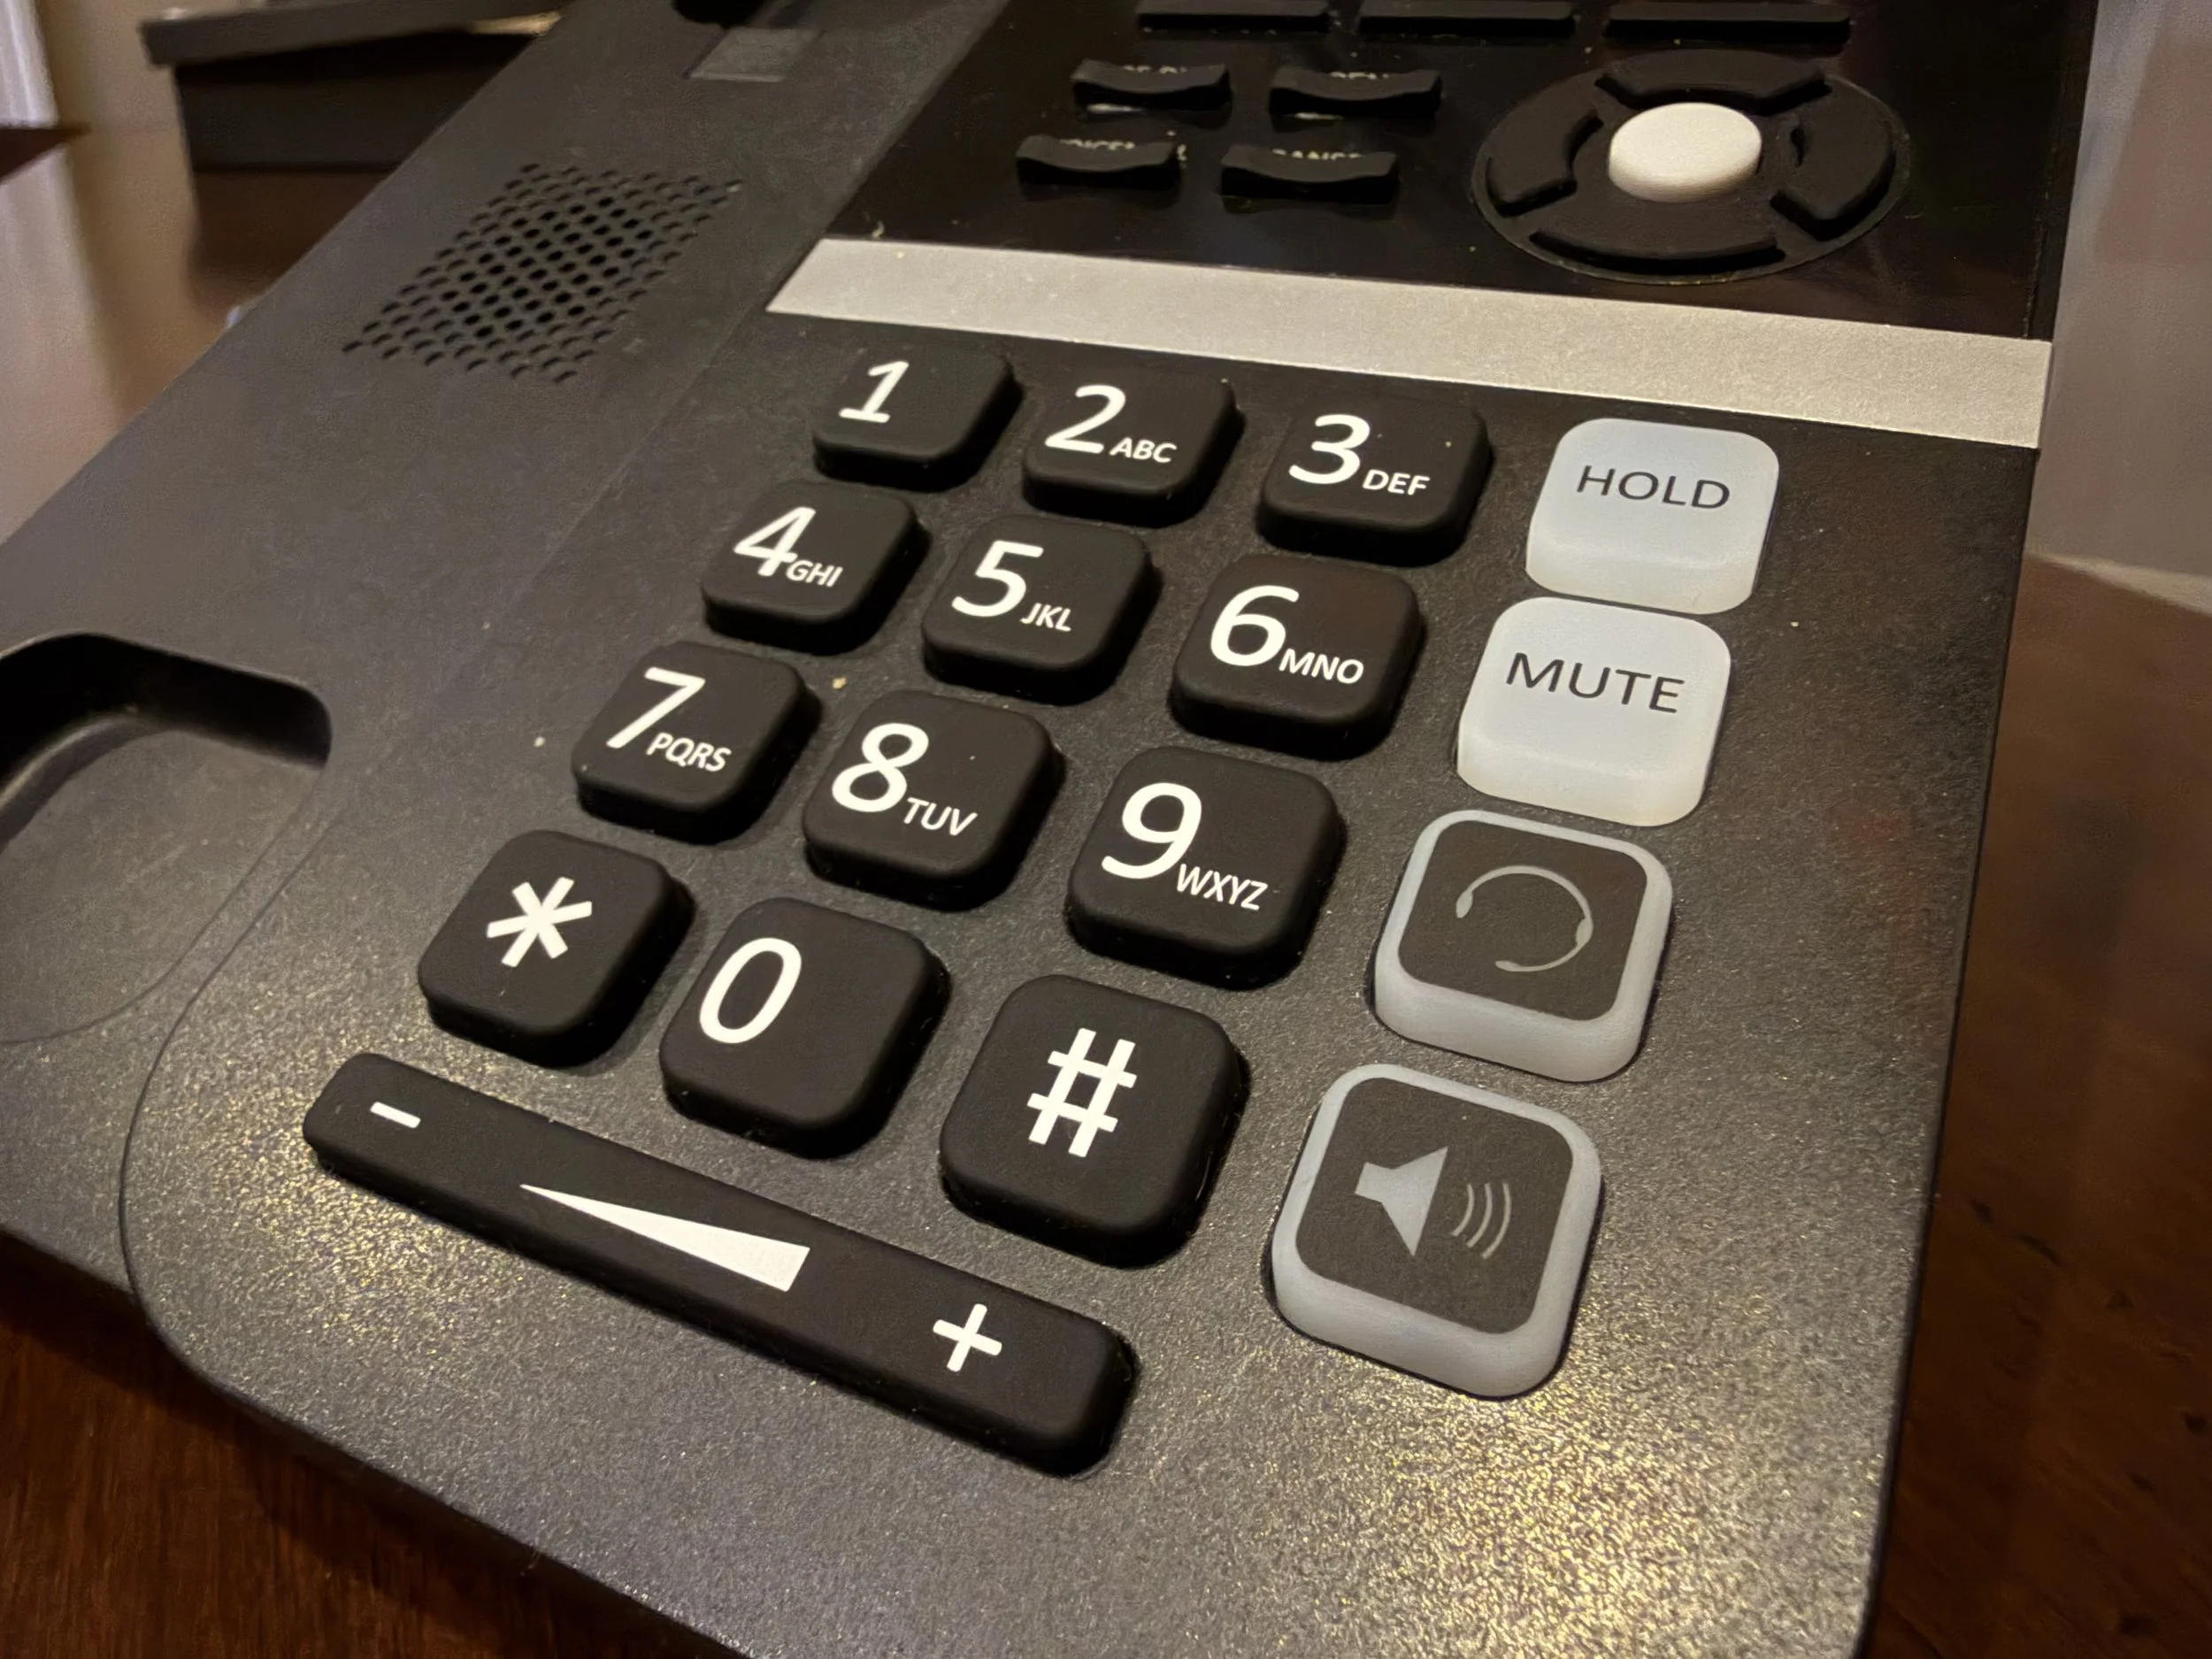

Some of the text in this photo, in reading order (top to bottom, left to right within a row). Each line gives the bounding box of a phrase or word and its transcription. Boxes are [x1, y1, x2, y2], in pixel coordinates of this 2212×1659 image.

[838, 360, 910, 424] 1
[1044, 384, 1178, 464] 2 ABC
[1288, 413, 1431, 496] 3 DEF
[1578, 465, 1730, 509] HOLD
[733, 506, 843, 588] 4 GHI
[951, 540, 1071, 632] 5 JKL
[1210, 584, 1364, 687] 6 MNO
[606, 666, 732, 775] 7 PQRS
[1506, 652, 1685, 716] MUTE
[831, 722, 978, 836] 8 TUV
[1101, 781, 1269, 912] 9 WXYZ
[699, 937, 803, 1044] 0
[1026, 1027, 1138, 1158] #
